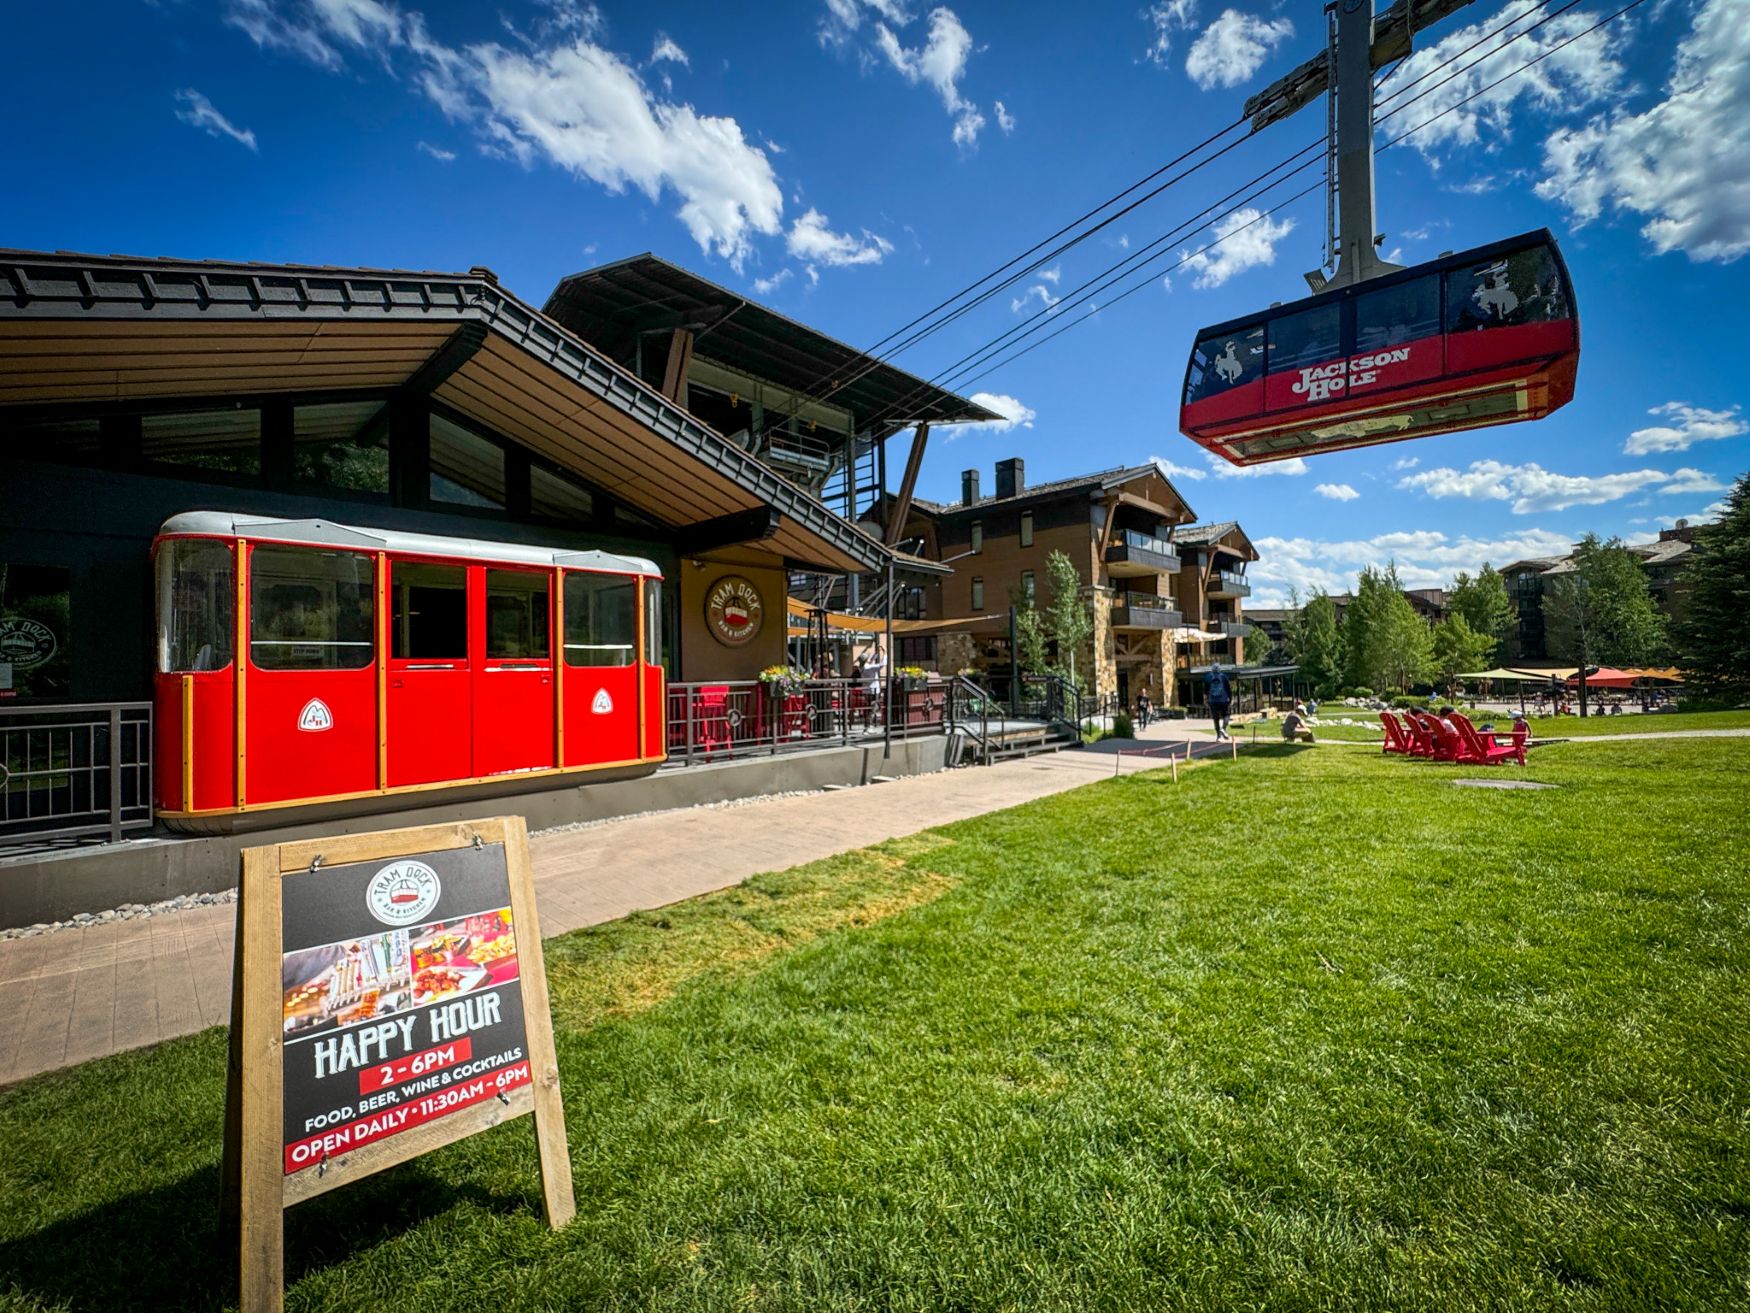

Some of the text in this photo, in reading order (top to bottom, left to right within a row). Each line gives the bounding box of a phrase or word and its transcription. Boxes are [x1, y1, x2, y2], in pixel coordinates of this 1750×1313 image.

[1291, 347, 1410, 393] JACKSON
[1307, 370, 1377, 402] HOLE
[711, 582, 761, 611] TRAM DOCK
[21, 621, 52, 642] DOCK
[374, 866, 432, 895] TRAM DOCK
[314, 991, 502, 1079] HAPPY HOUR
[380, 1066, 394, 1085] 2
[411, 1045, 455, 1074] 6PM
[305, 1047, 522, 1132] FOOD, BEER, WINE & COCKTAILS
[292, 1129, 350, 1162] OPEN
[354, 1107, 409, 1140] DAILY
[420, 1081, 484, 1116] 11:30AM
[495, 1065, 528, 1087] 6PM
